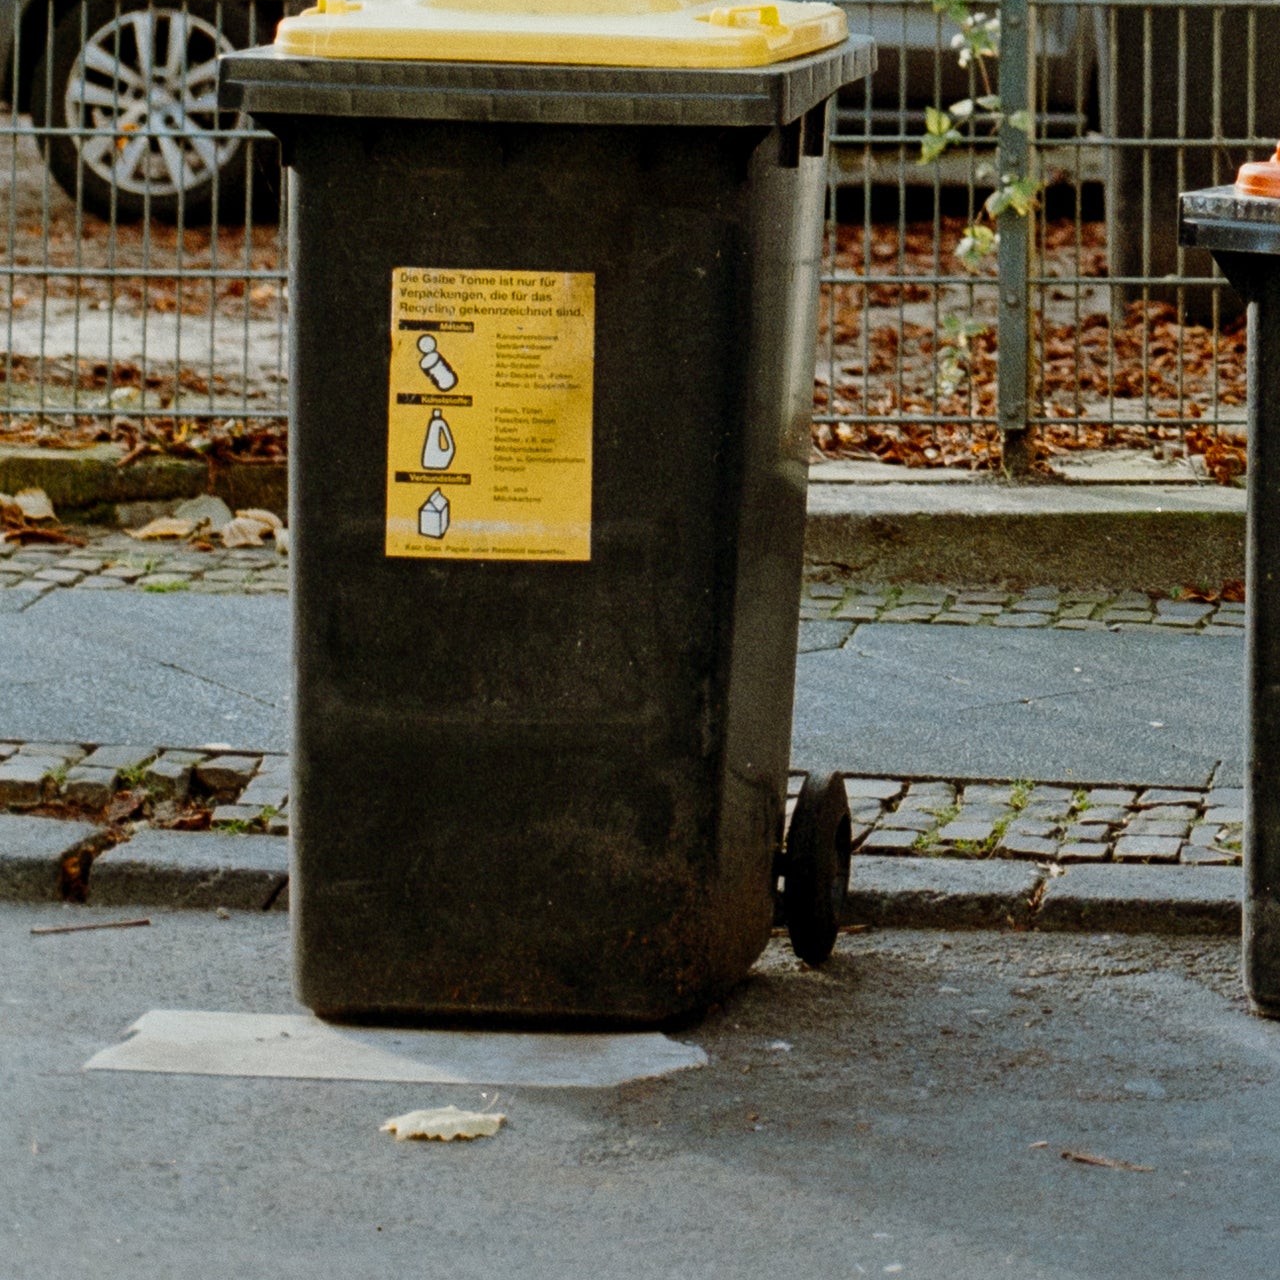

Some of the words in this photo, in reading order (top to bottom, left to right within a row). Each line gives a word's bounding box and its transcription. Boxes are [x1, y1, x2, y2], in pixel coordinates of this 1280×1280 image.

[400, 274, 419, 283] Die
[460, 275, 496, 286] Tonne
[499, 276, 514, 286] ist
[517, 278, 536, 287] nur
[540, 277, 556, 288] für
[490, 291, 508, 301] die
[511, 291, 527, 302] für
[532, 292, 552, 302] das
